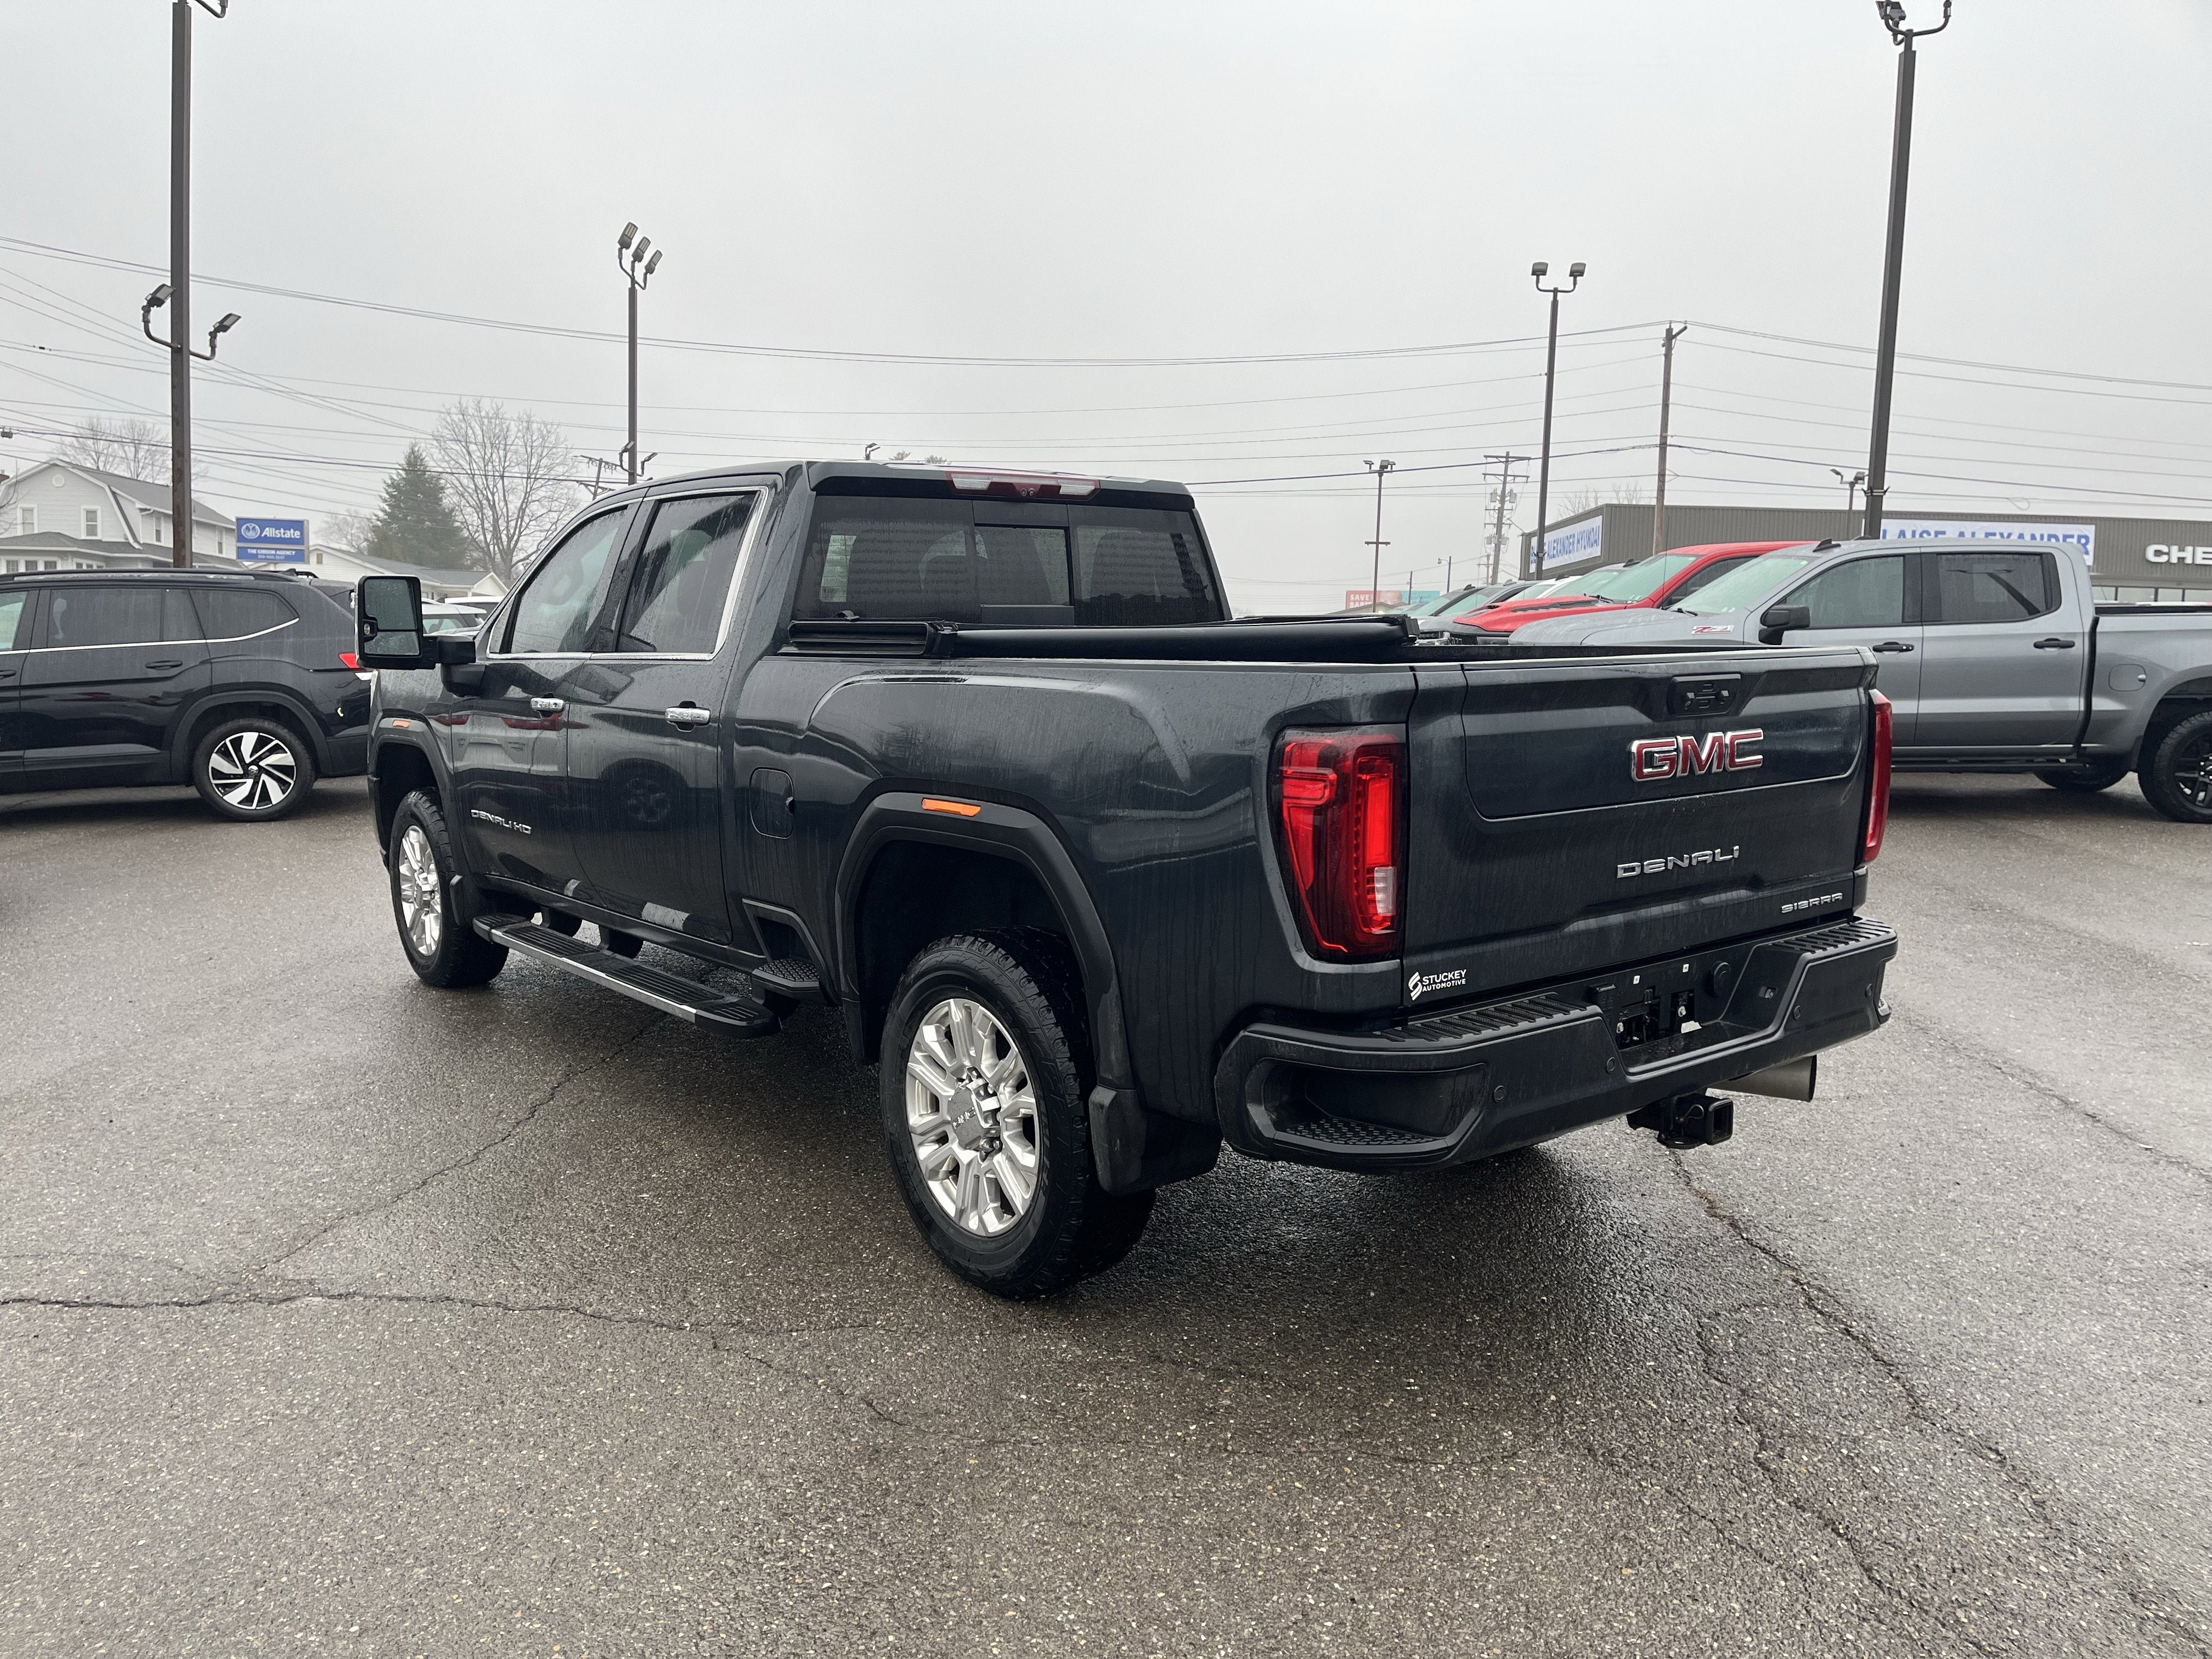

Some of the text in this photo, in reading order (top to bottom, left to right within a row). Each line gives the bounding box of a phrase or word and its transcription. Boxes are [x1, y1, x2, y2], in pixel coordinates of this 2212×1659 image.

[261, 527, 301, 539] Allstate
[1547, 534, 1575, 560] ALEXANDER
[1576, 525, 1600, 552] HYUNDAI
[2145, 544, 2212, 565] CHE
[1629, 728, 1764, 782] GMC
[471, 809, 532, 834] DENALI HD
[1617, 845, 1740, 878] DENALI
[1781, 893, 1843, 913] SIERRA
[1422, 969, 1466, 985] STUCKEY
[1422, 979, 1466, 992] AUTOMOTIVE
